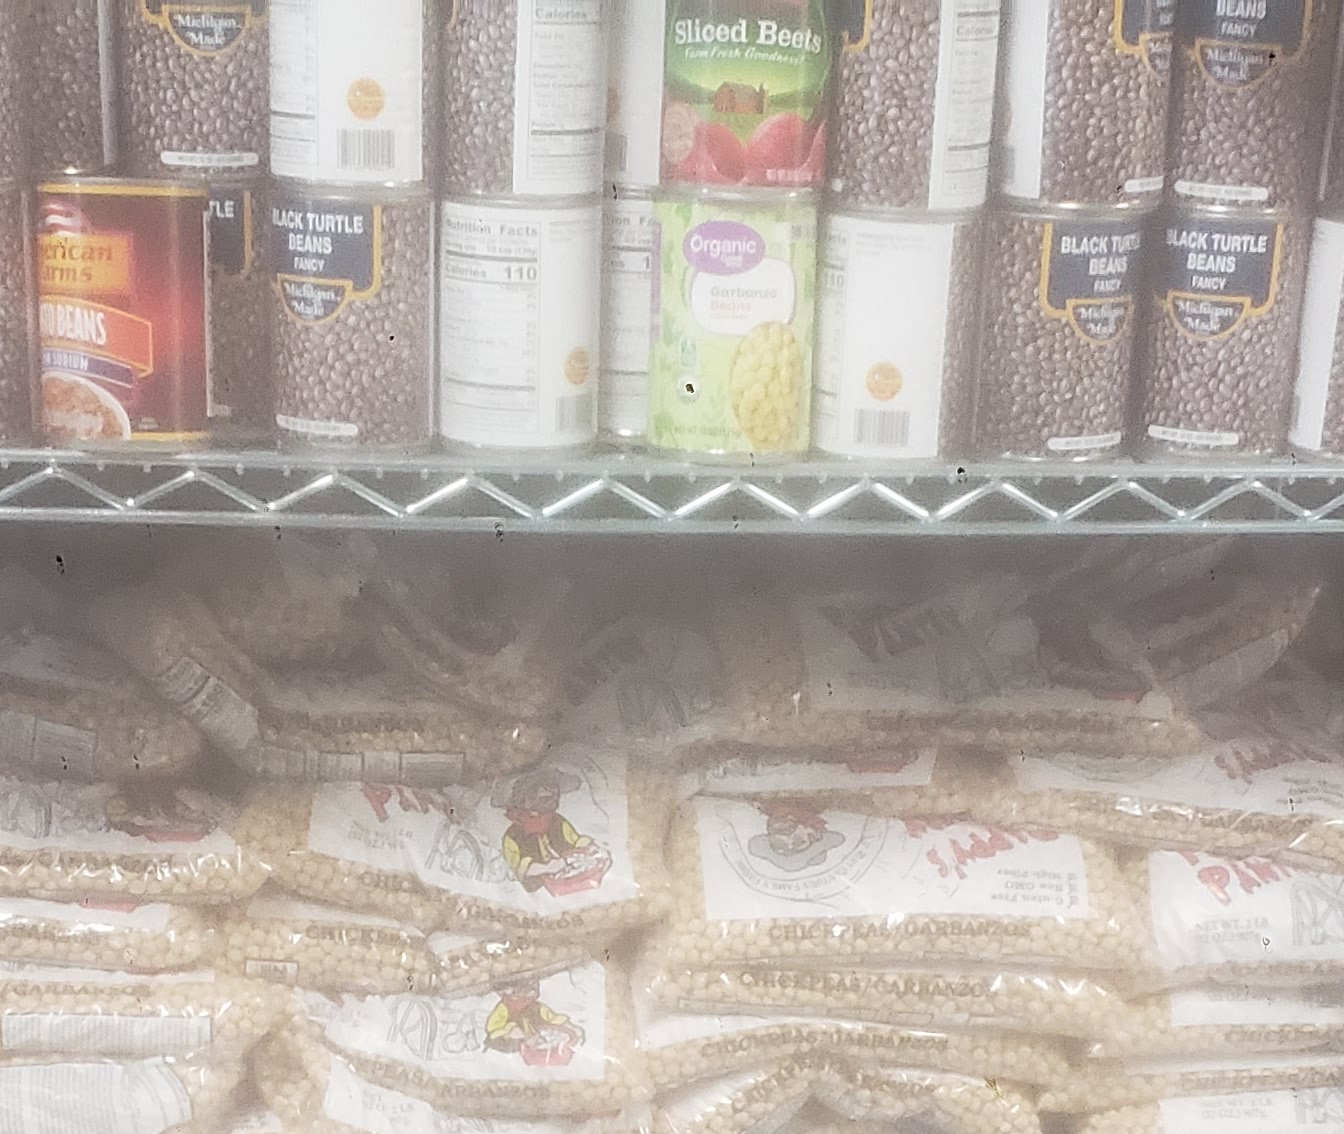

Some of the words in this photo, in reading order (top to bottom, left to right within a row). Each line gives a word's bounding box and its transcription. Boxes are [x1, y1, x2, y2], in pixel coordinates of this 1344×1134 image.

[675, 18, 748, 45] Sliced
[756, 20, 822, 54] Beets
[306, 211, 364, 234] TURTLE
[499, 223, 538, 238] Facts
[288, 232, 333, 255] BEANS
[689, 233, 757, 258] Organic
[1060, 234, 1111, 256] BLACK
[1211, 233, 1268, 254] TURTLE
[293, 256, 325, 273] FANCY
[503, 265, 538, 281] 110
[1186, 252, 1236, 273] BEANS
[1192, 275, 1227, 291] FANCY
